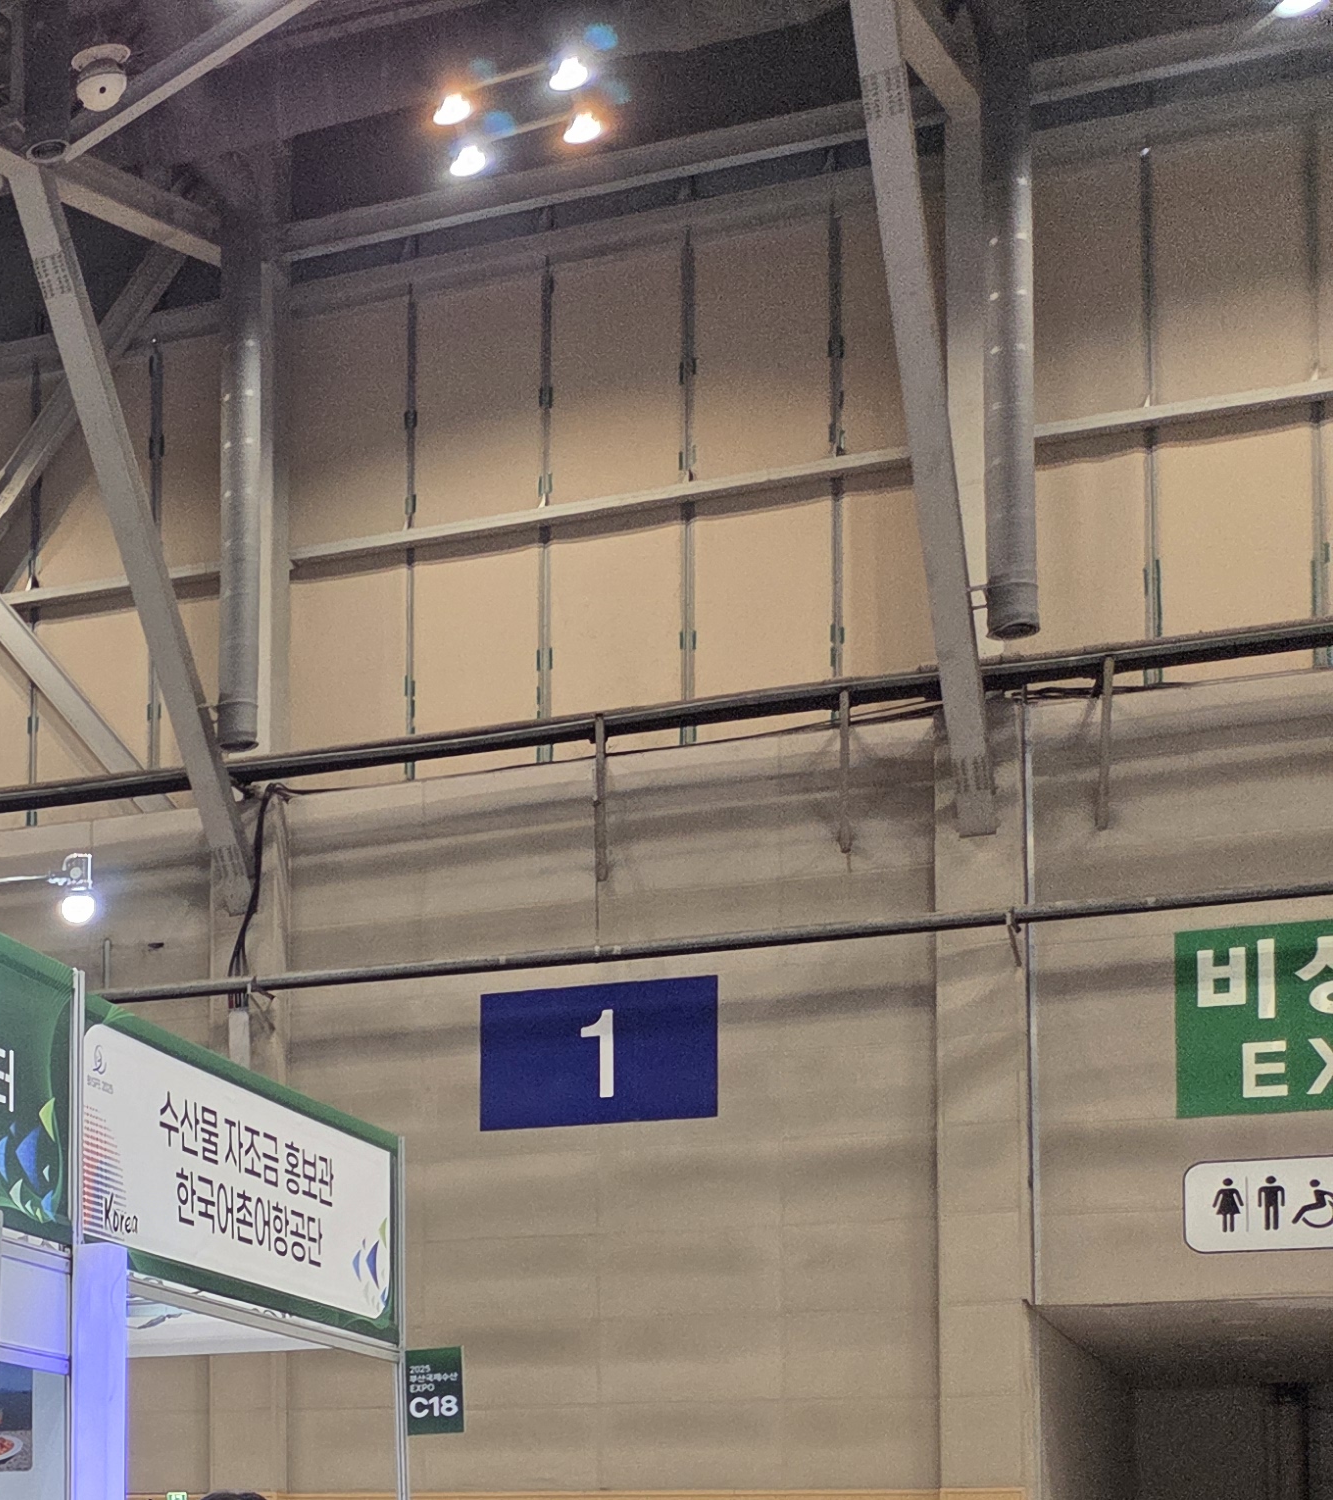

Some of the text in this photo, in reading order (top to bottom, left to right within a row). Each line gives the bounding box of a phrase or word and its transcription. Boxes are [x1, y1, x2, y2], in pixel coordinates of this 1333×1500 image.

[581, 1009, 614, 1099] 1
[159, 1092, 334, 1207] 수산물 자조금 홍보관
[104, 1192, 138, 1234] Korea
[175, 1168, 323, 1268] 한국어촌어항공단
[409, 1395, 459, 1418] C18
